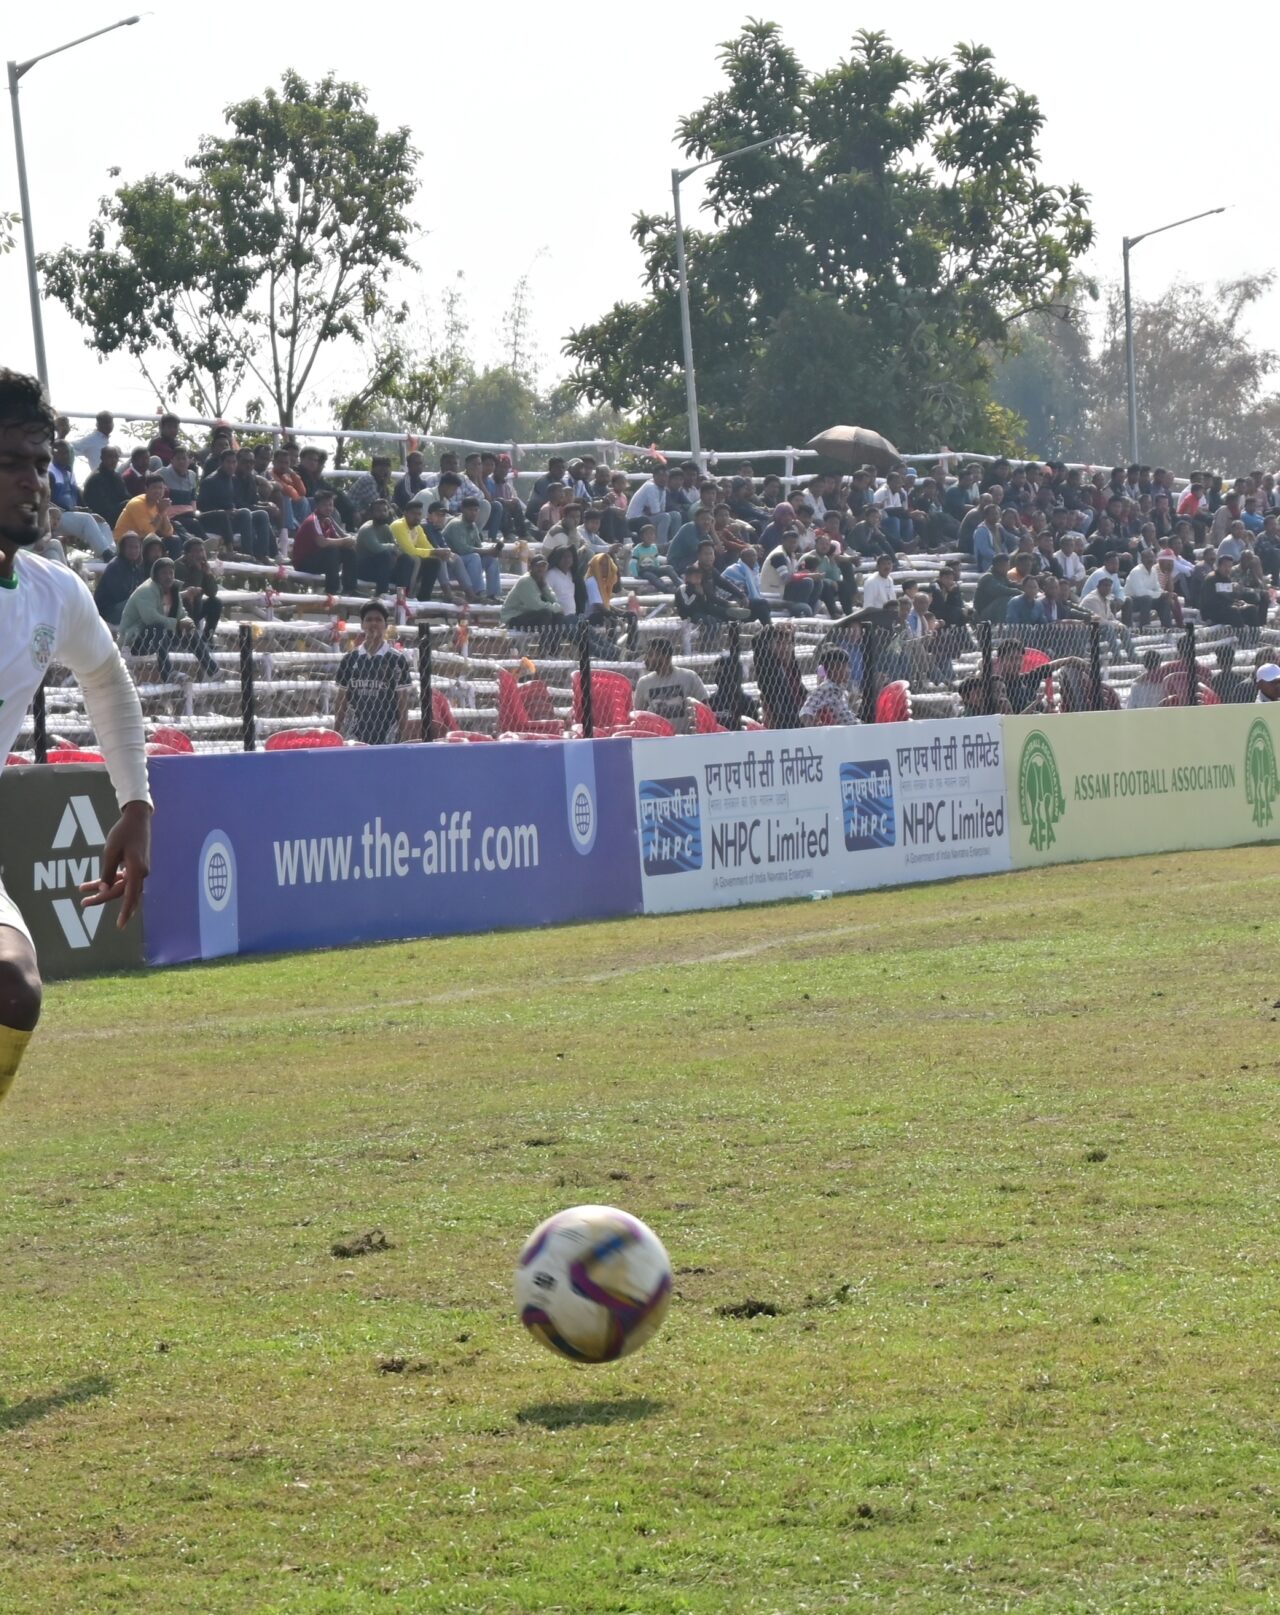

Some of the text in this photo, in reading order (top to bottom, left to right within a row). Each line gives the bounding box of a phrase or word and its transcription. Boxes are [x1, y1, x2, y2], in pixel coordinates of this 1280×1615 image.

[780, 745, 823, 786] लिमिटेड
[962, 732, 999, 769] लिमिटेड
[1074, 764, 1236, 801] ASSAM FOOTBALL ASSOCIATION
[711, 812, 829, 870] NHPC Limited
[903, 795, 1004, 846] NHPC Limited
[273, 811, 539, 886] www.the-aiff.com
[34, 855, 125, 891] NIVI
